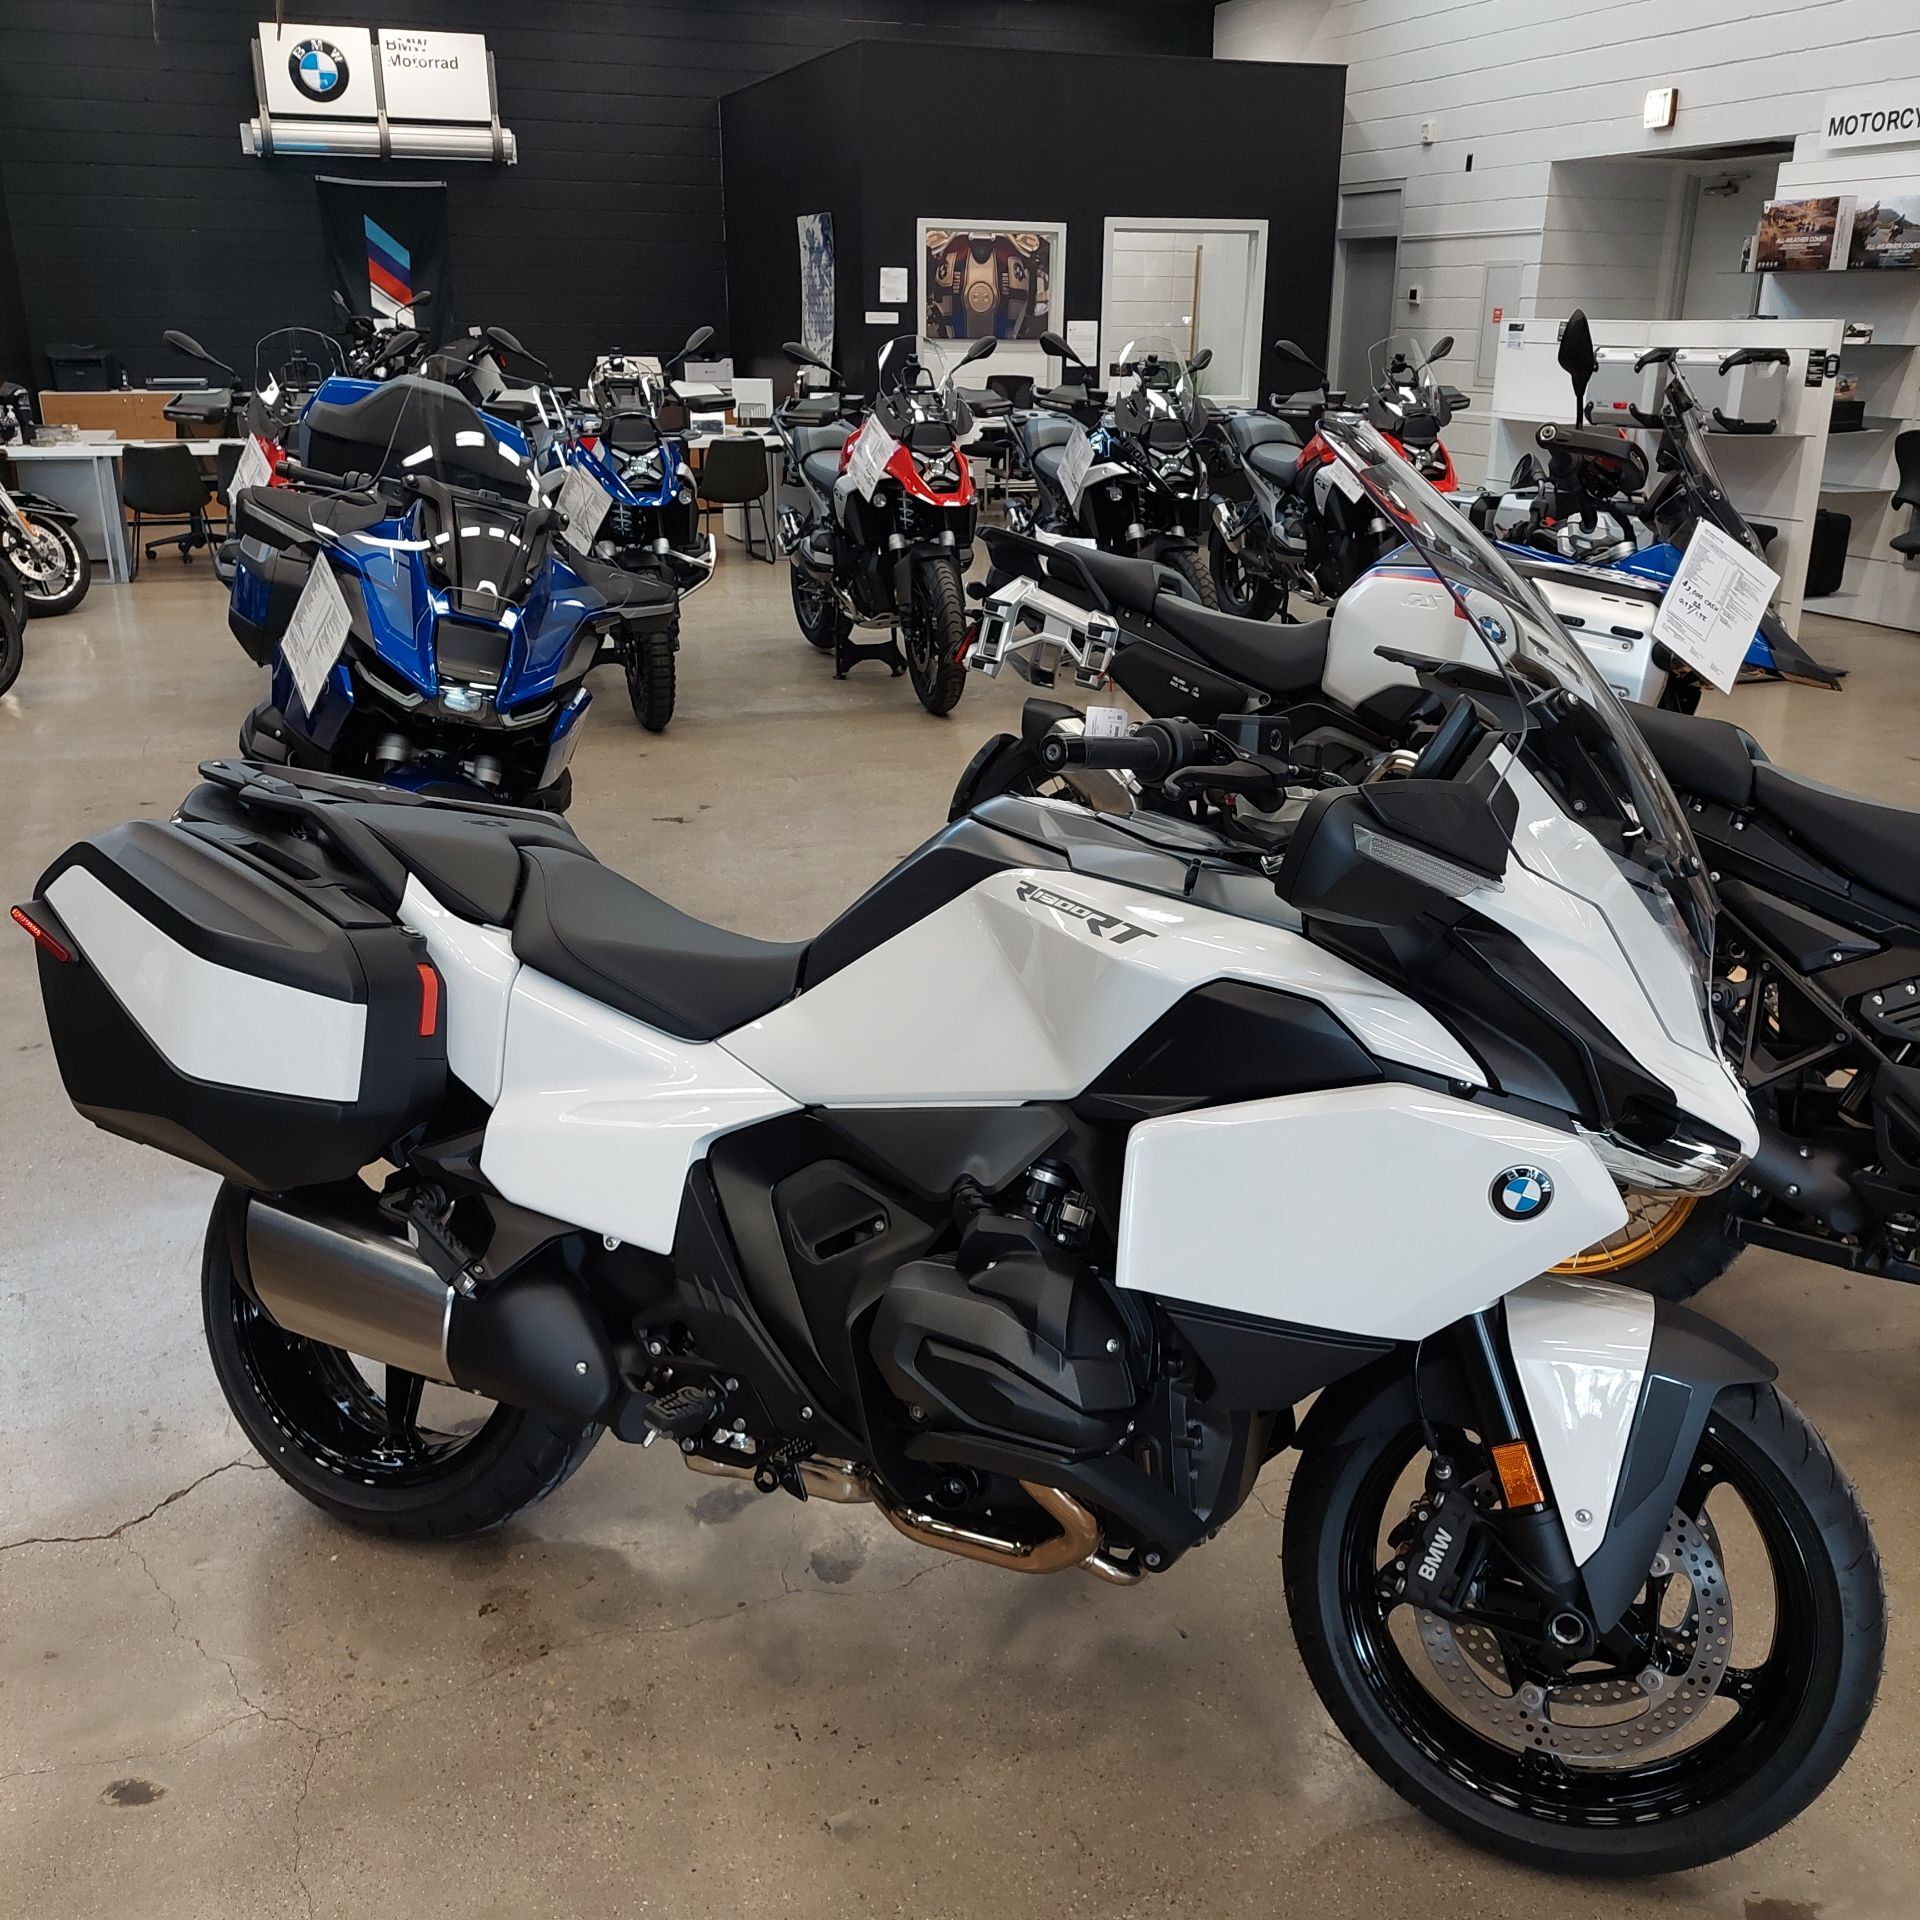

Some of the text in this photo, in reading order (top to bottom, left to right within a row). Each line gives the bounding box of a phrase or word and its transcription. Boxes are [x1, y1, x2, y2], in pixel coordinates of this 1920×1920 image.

[292, 39, 344, 63] BMW
[388, 54, 459, 70] Motorrad
[1505, 1168, 1552, 1193] BMW
[1417, 1526, 1453, 1582] BMW
